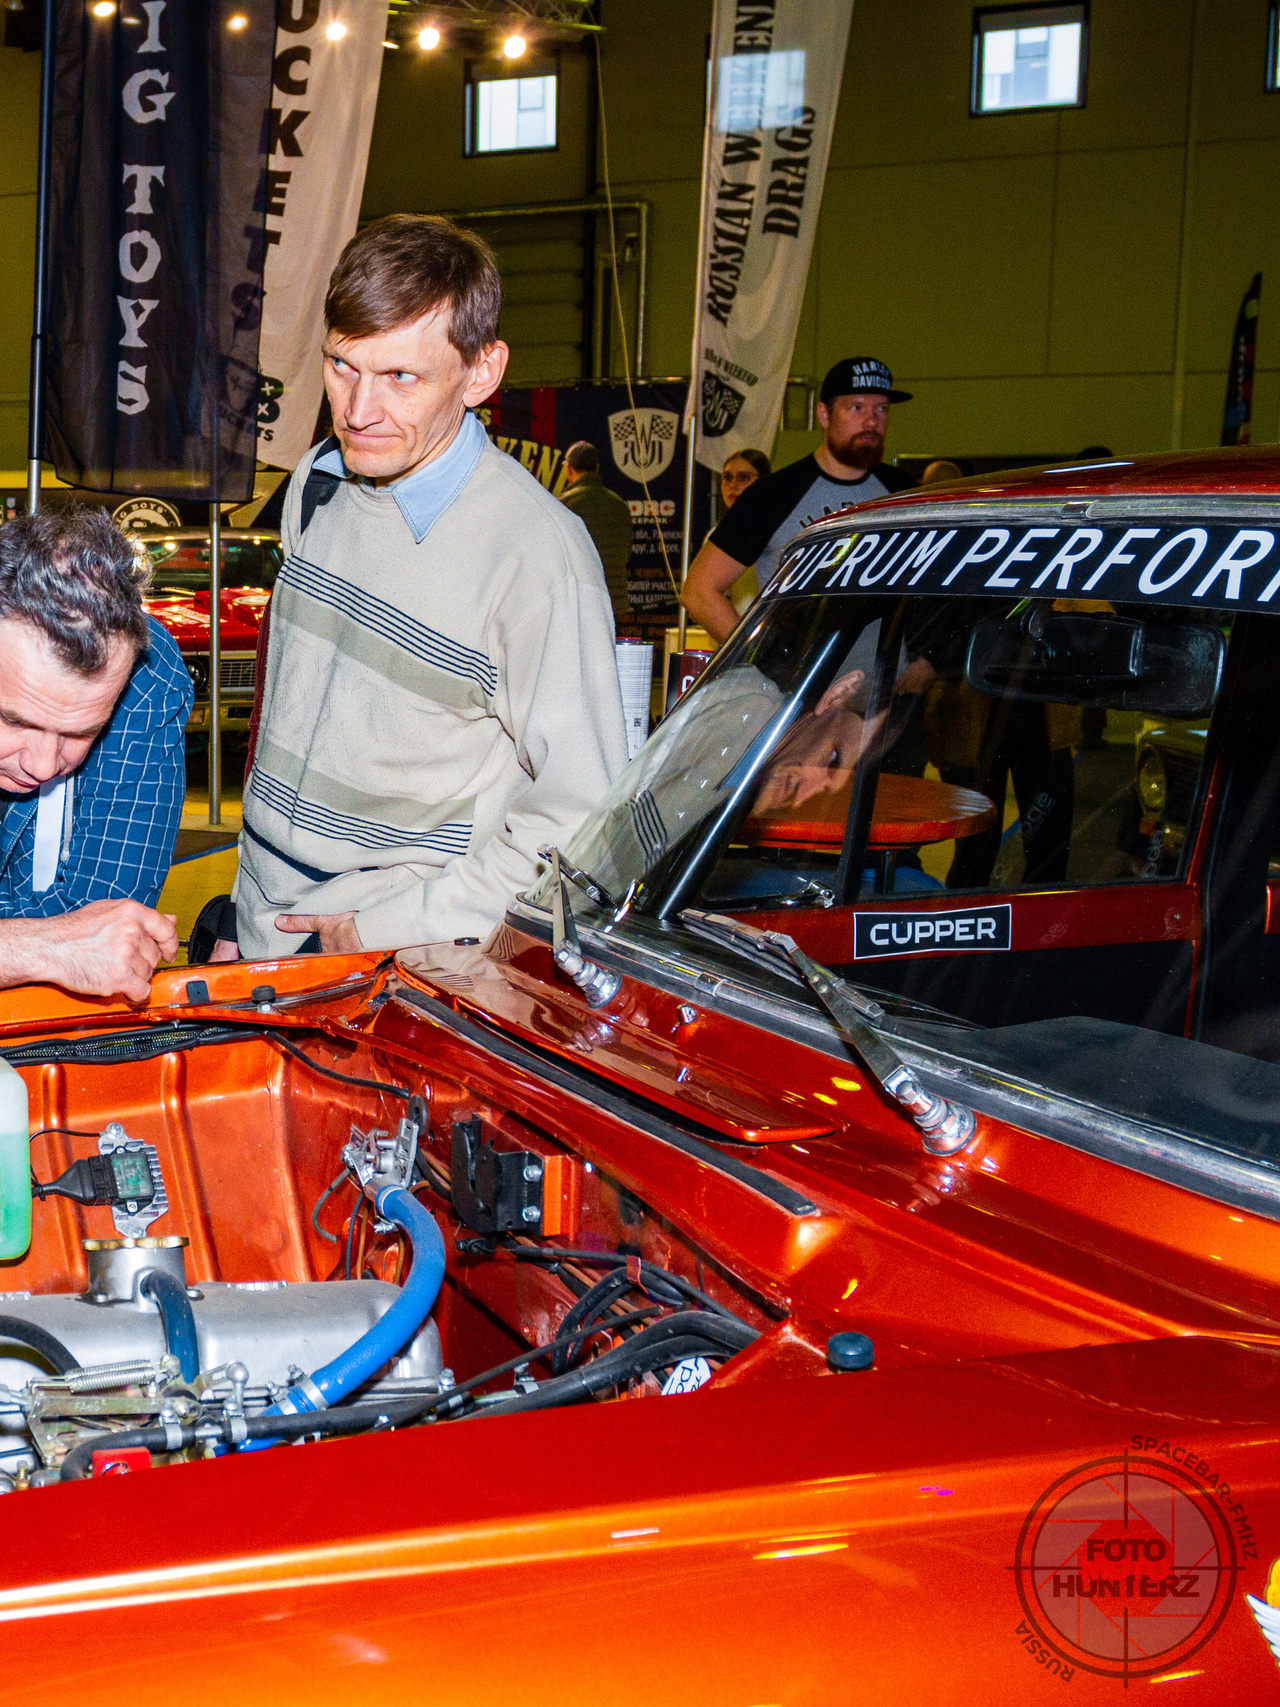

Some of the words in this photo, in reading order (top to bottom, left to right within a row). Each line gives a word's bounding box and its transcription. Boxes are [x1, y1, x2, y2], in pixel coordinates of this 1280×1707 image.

[762, 104, 818, 240] DRAGS
[116, 163, 167, 416] TOYS
[760, 529, 959, 599] CUPRUM
[870, 917, 997, 946] CUPPER
